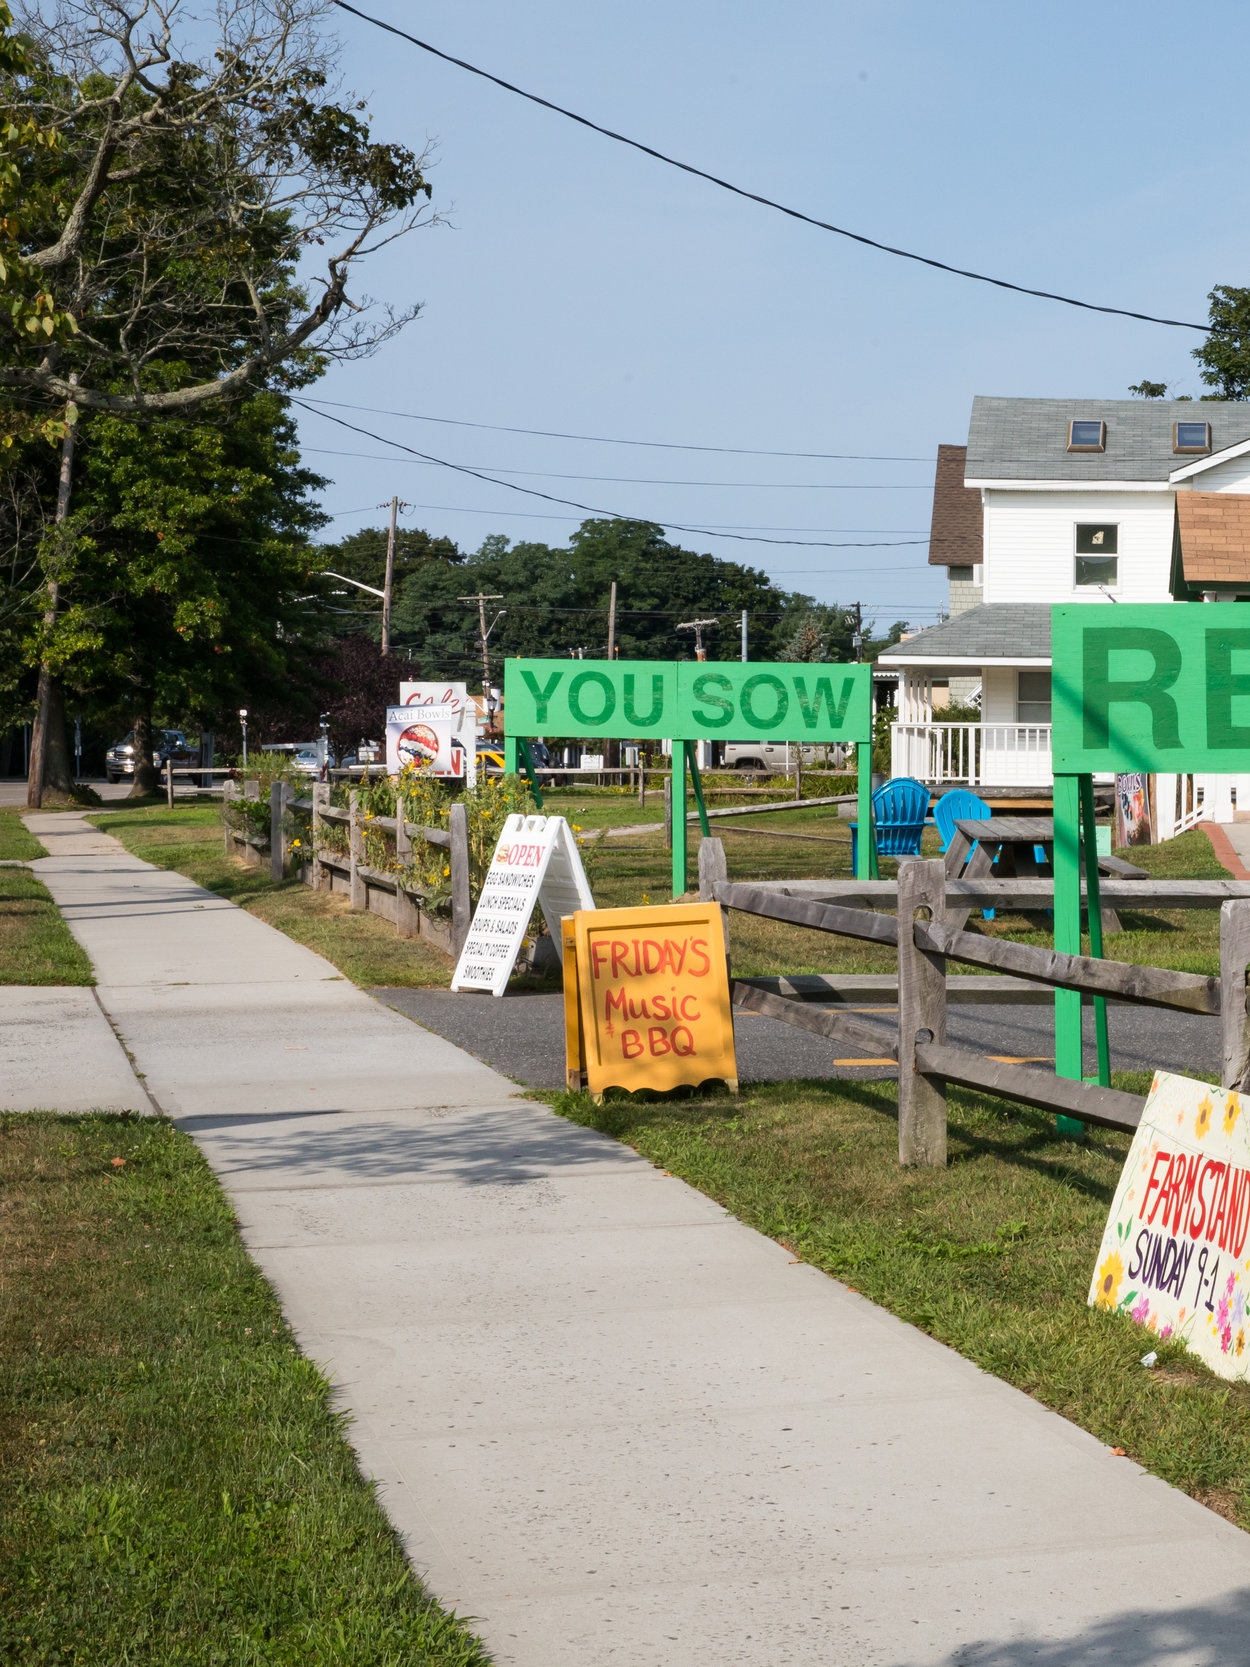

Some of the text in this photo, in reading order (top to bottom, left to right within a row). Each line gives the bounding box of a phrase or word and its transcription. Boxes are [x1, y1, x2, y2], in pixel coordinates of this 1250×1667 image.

[519, 670, 855, 730] YOU SOW
[418, 708, 451, 720] Bowls
[507, 844, 546, 868] OPEN
[486, 872, 536, 888] EGG SANDWICHES
[480, 896, 527, 911] LUNCH SPECIALS
[472, 918, 492, 932] SOUPS
[495, 920, 519, 935] SALADS
[465, 941, 510, 959] SPECIALTY COFFEE
[591, 936, 711, 979] FRIDAY'S
[463, 965, 496, 981] SMOOTHIES
[605, 987, 701, 1023] Music
[621, 1026, 697, 1059] BBQ
[1128, 1229, 1221, 1312] SUNDAY 9-1
